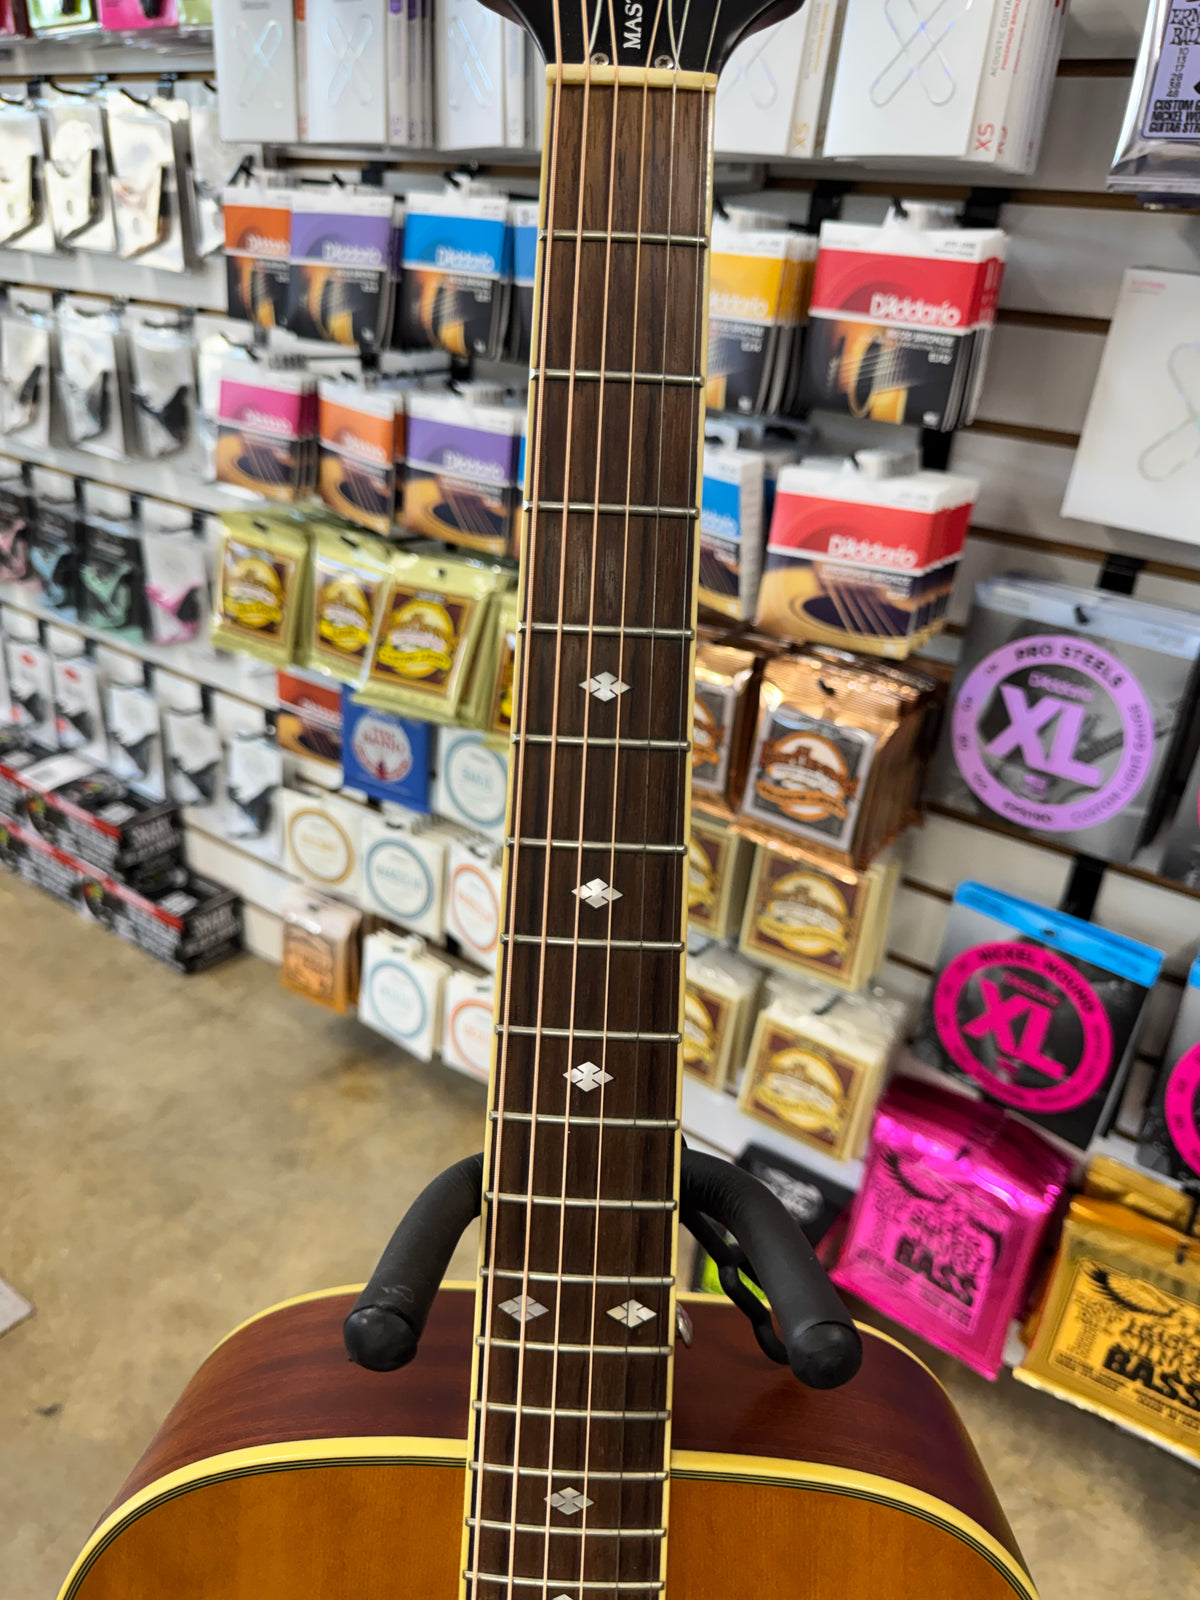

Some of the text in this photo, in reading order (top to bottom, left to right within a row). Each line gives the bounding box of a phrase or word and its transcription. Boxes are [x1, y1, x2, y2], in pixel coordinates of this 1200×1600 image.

[622, 0, 643, 50] MAS
[1148, 122, 1182, 133] GUITAR
[1151, 111, 1183, 122] NICKEL
[1153, 99, 1194, 111] CUSTOM
[1014, 643, 1125, 689] PRO STEELS
[985, 683, 1103, 788] XL
[977, 948, 1095, 1014] NICKEL WOUND
[961, 975, 1066, 1080] XL
[1102, 1342, 1200, 1412] BASS
